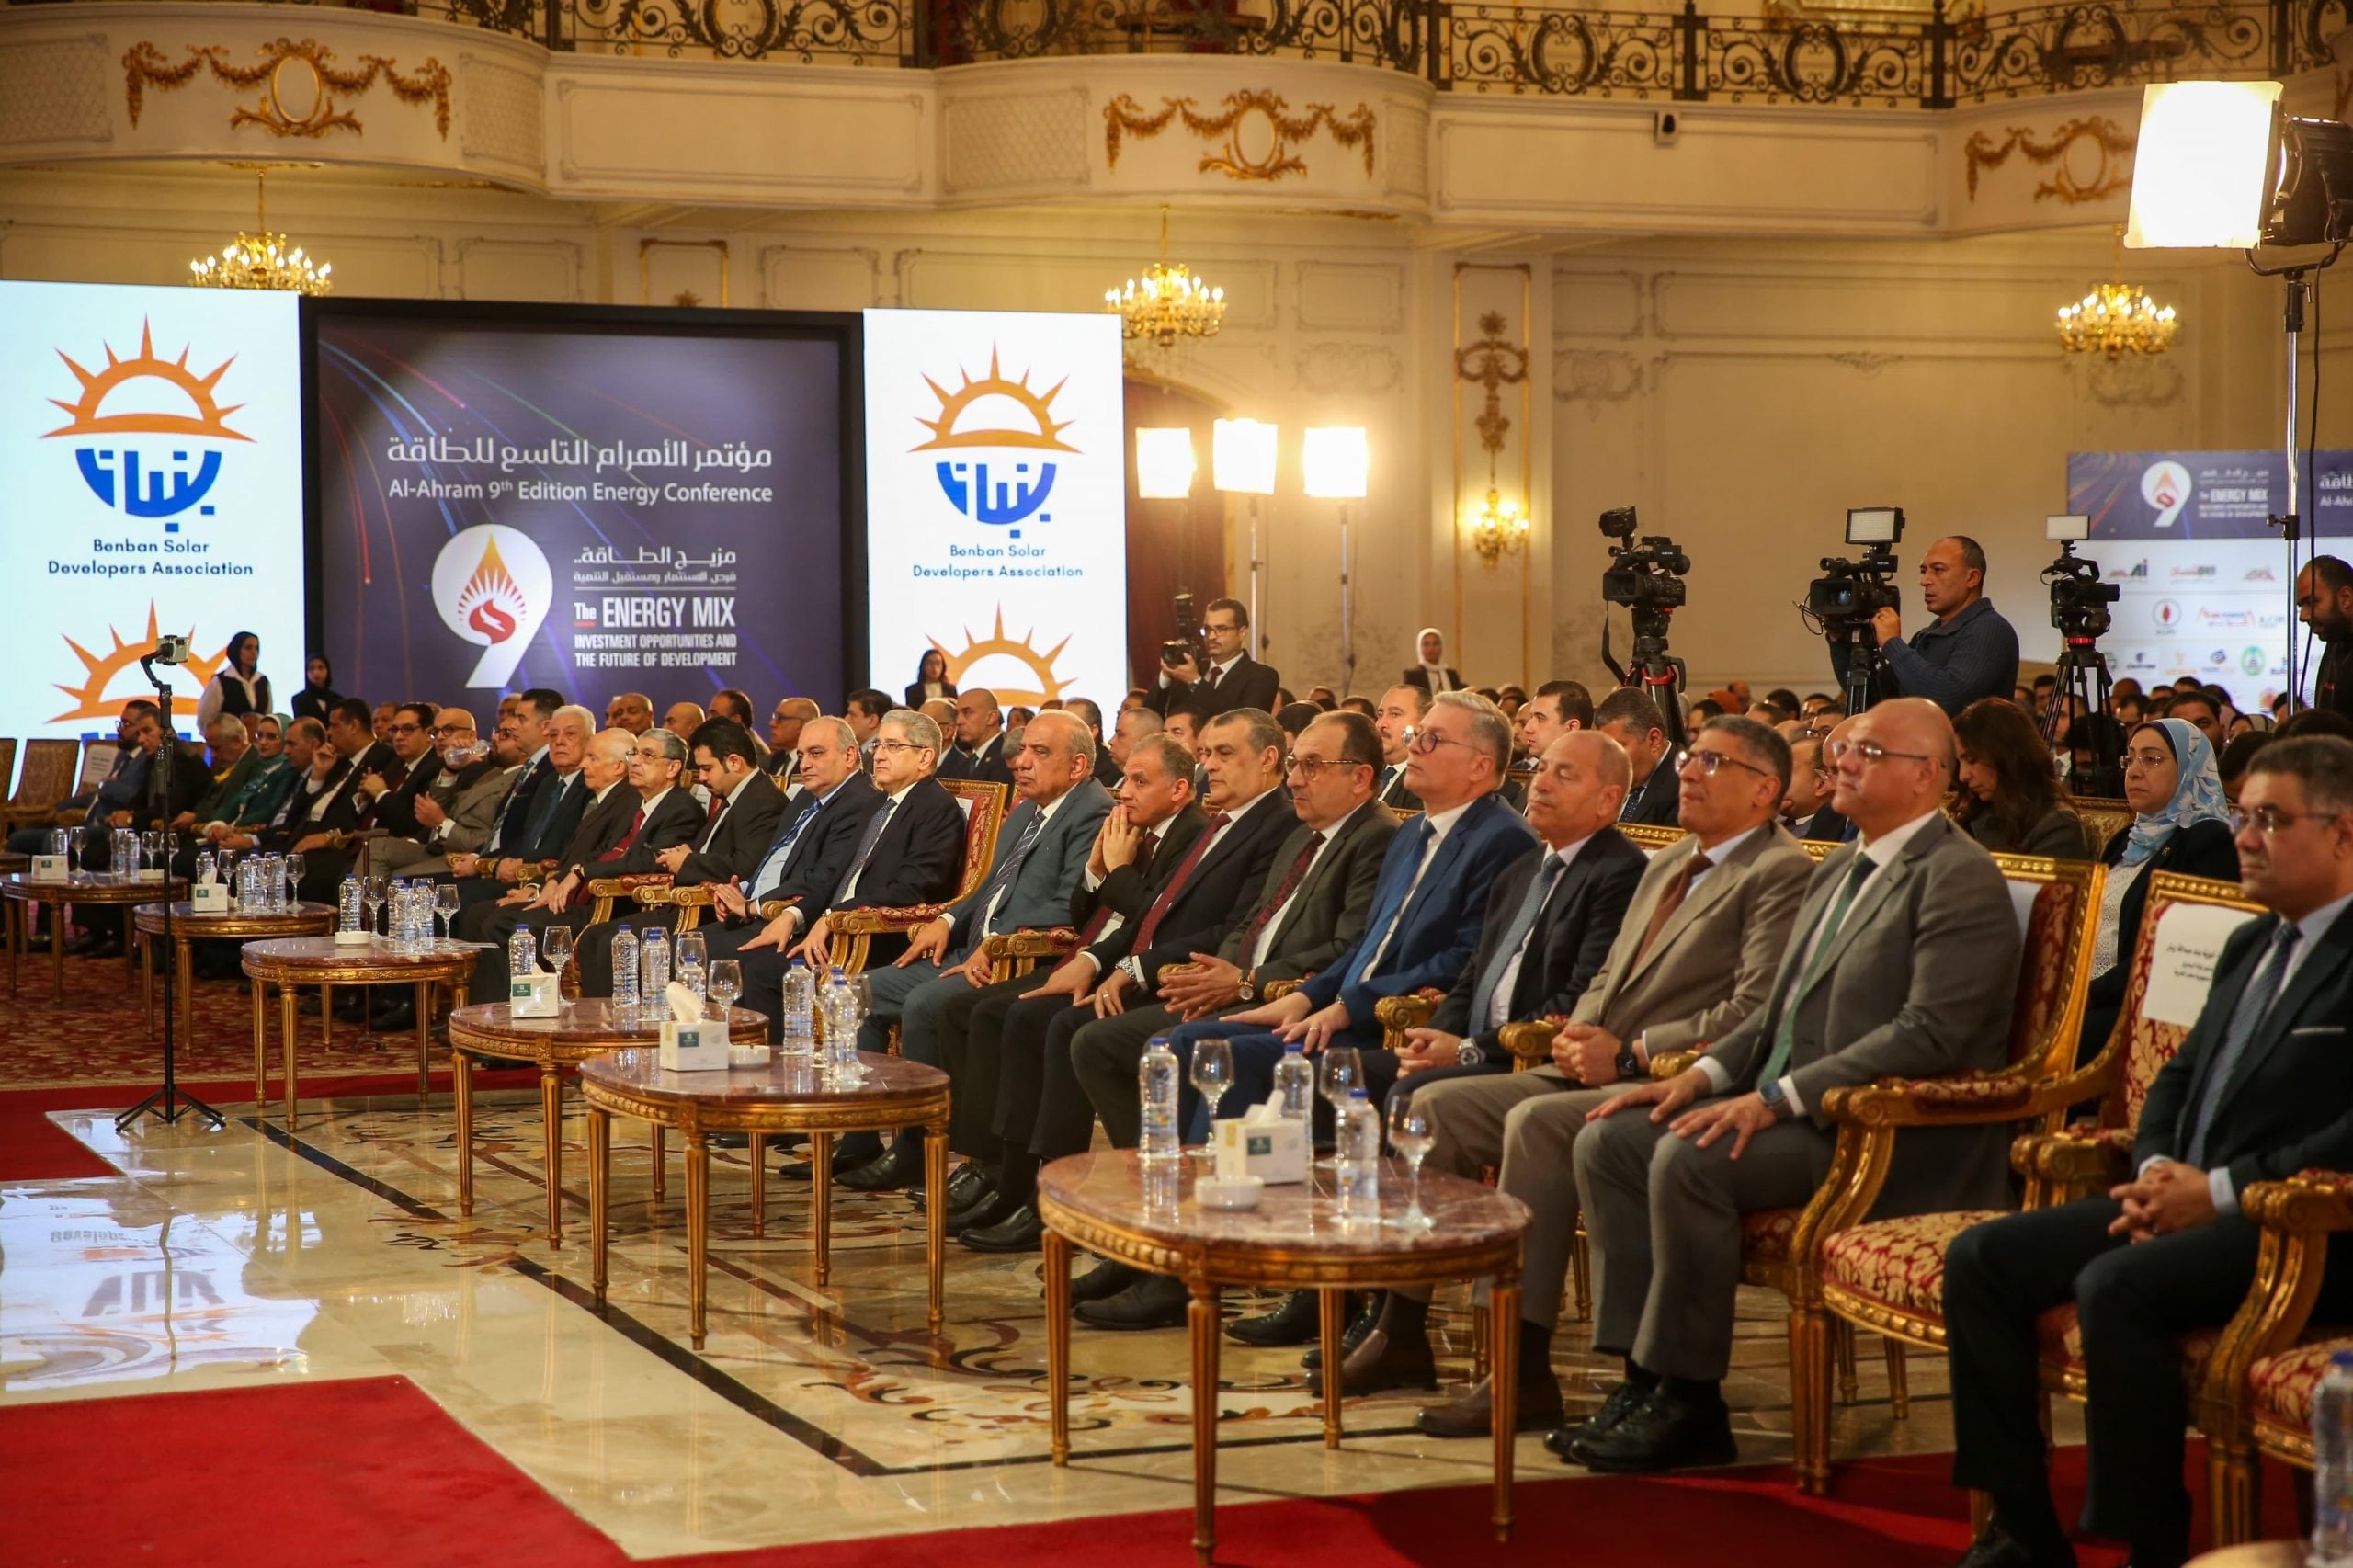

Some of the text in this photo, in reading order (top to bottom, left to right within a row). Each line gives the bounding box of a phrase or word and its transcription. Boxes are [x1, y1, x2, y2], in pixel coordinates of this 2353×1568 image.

[387, 437, 773, 473] مؤتمر الأهرام التاسع للطاقة
[388, 479, 773, 506] Al-Ahram 9th Edition Energy Conference
[2210, 488, 2246, 502] ENERGY
[93, 539, 210, 552] Benban Solar
[950, 544, 1046, 557] Benban Solar
[48, 560, 254, 578] Developers Association
[913, 564, 1083, 581] Developers Association
[574, 597, 736, 628] The ENERGY MIX
[574, 634, 737, 649] INVESTMENT OPPORTUNITIES AND
[575, 652, 737, 667] THE FUTURE OF DEVELOPMENT
